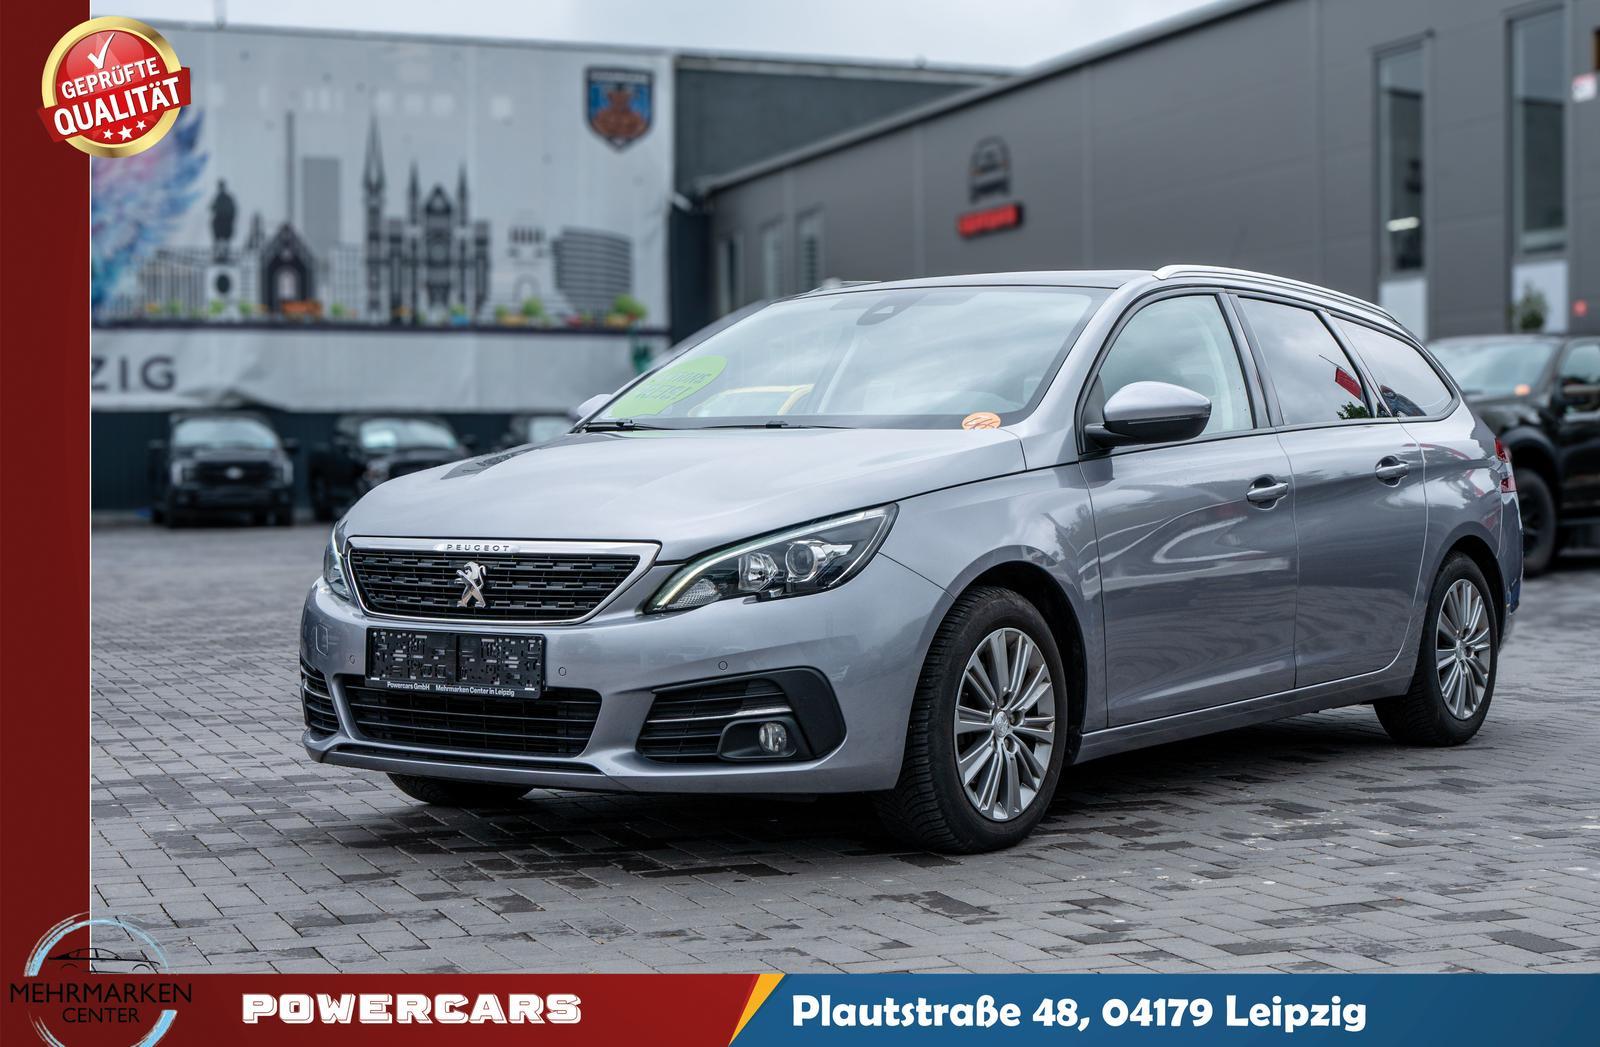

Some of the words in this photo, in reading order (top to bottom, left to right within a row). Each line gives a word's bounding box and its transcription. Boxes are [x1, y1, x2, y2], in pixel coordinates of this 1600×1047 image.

[446, 543, 510, 552] PEUGEOT
[387, 681, 413, 690] Powercars
[435, 684, 469, 694] Mehrmarken
[469, 686, 489, 695] Center
[495, 688, 515, 697] Leipzig
